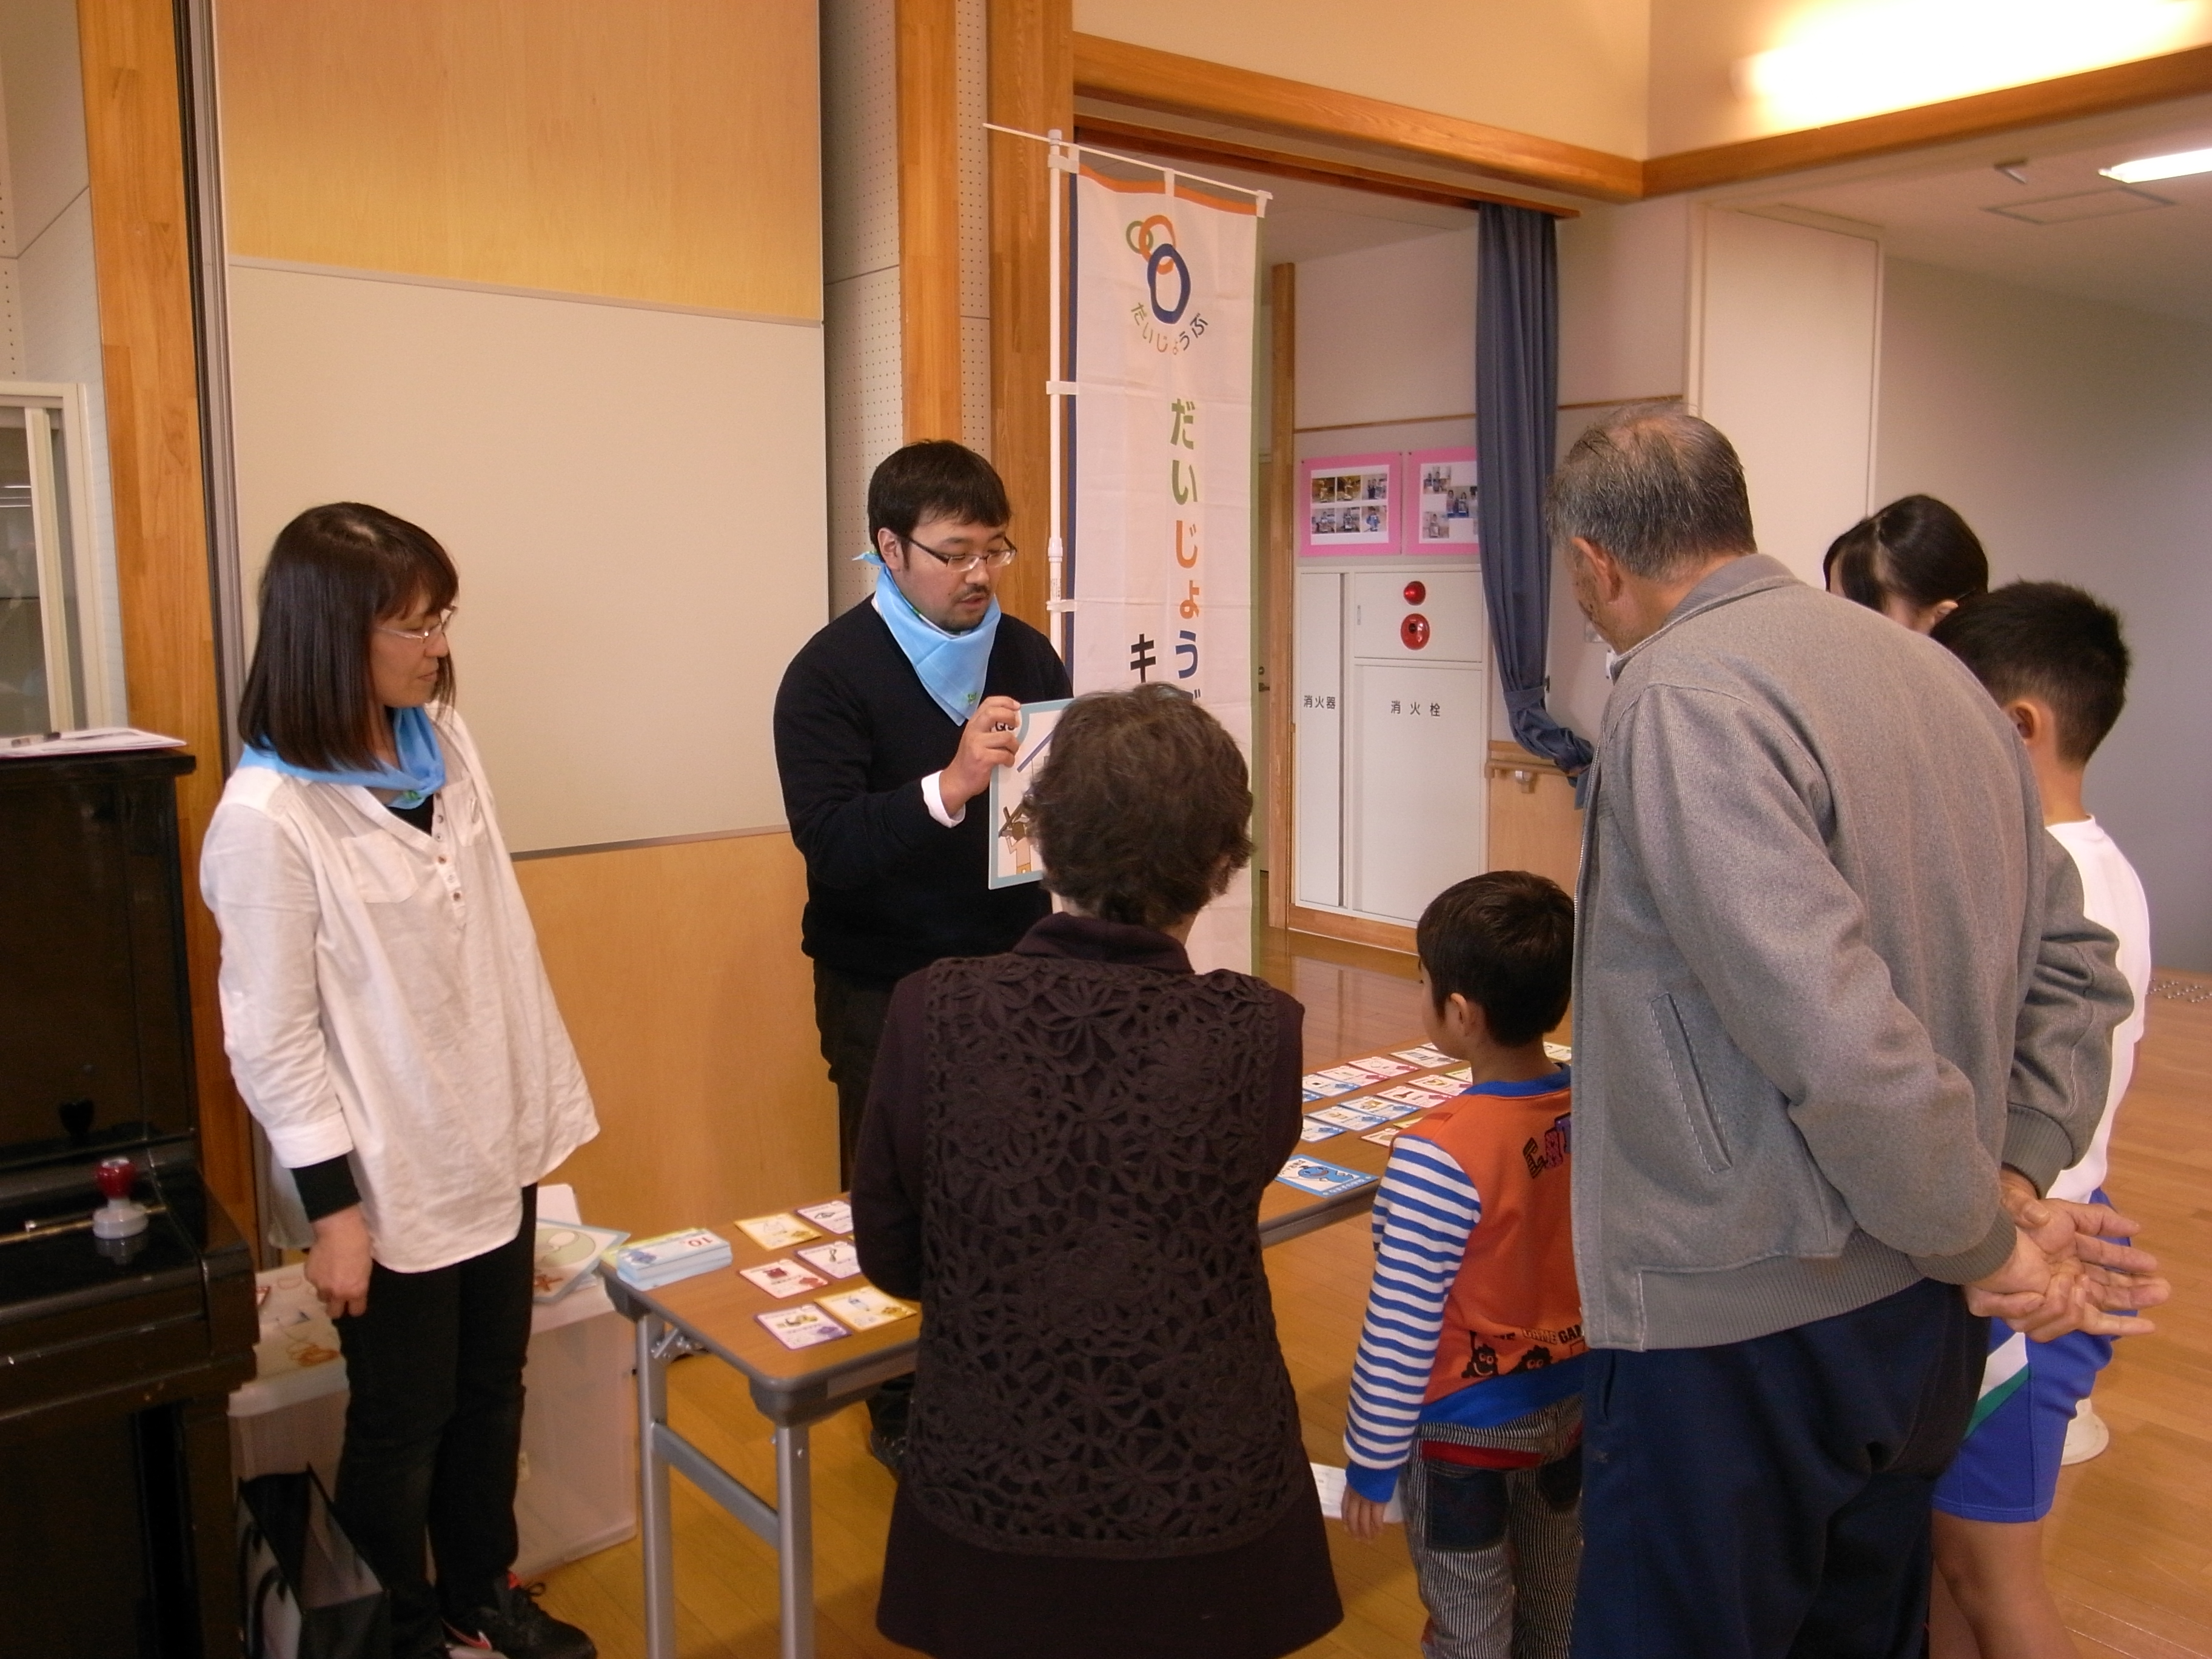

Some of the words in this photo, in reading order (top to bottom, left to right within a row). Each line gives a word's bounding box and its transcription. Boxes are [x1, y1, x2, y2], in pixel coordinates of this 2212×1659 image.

[1130, 302, 1208, 355] だいじょうぶ
[1170, 397, 1201, 701] だいじょう
[1303, 695, 1336, 710] 消火器
[1390, 700, 1441, 717] 消火栓
